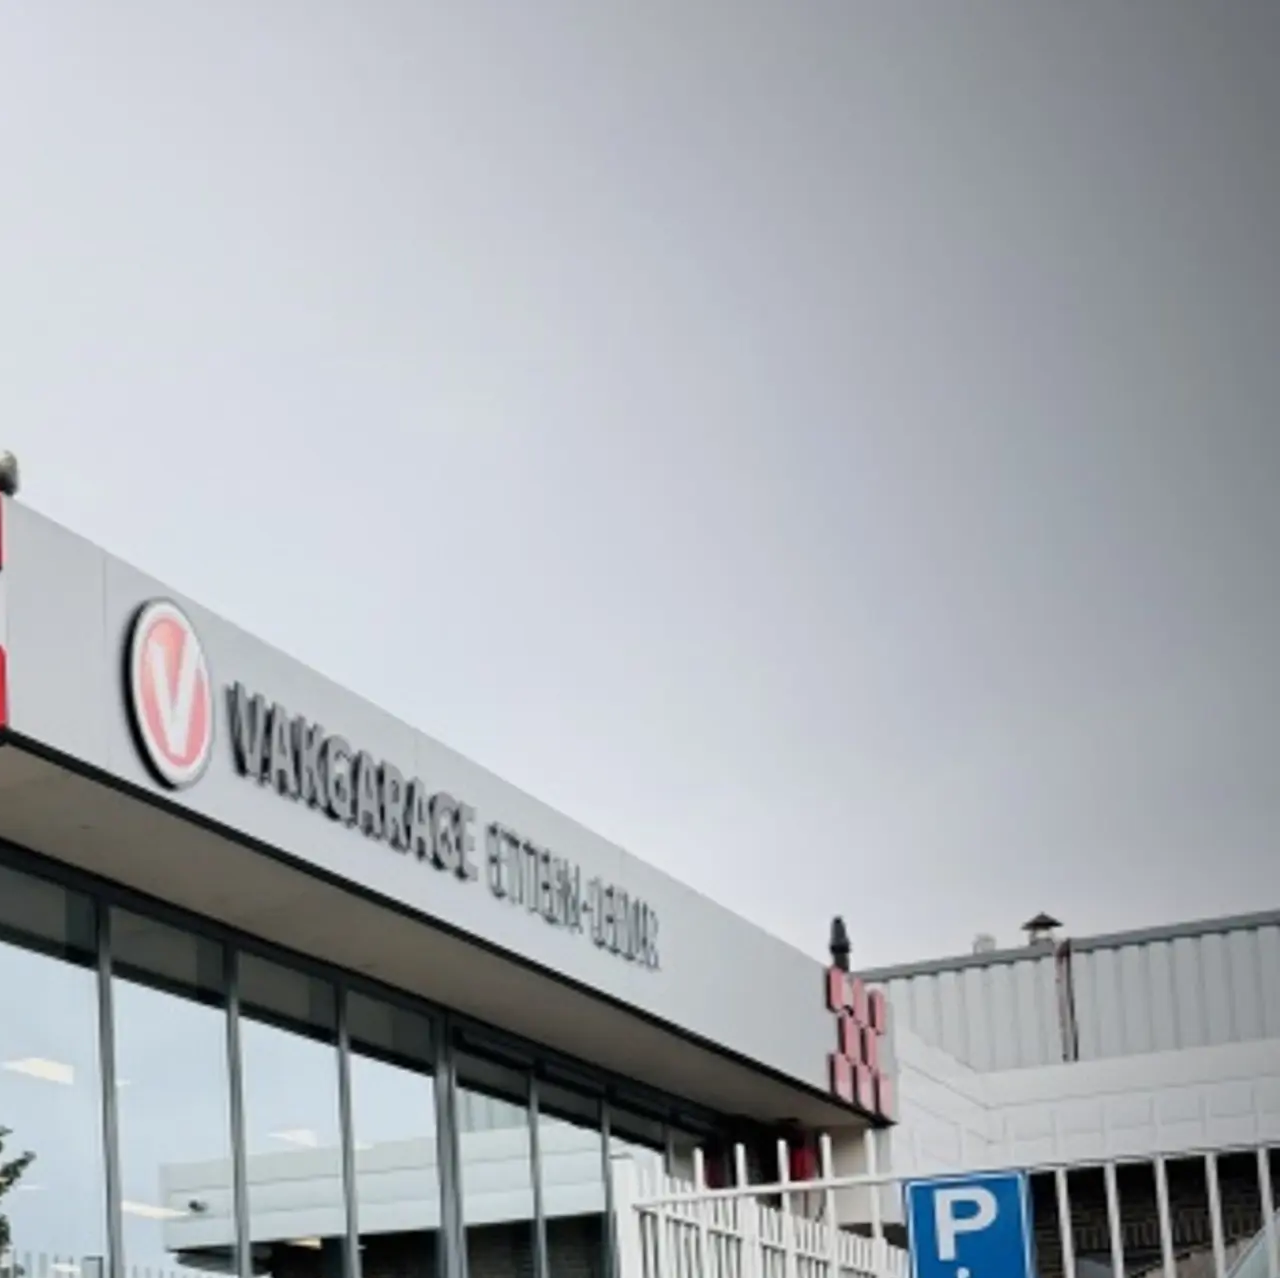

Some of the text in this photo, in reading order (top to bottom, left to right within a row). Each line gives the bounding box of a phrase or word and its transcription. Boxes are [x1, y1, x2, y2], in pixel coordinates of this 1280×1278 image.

[225, 681, 660, 972] VAKGARAGE ETTEN-LEUR
[933, 1186, 998, 1261] P
